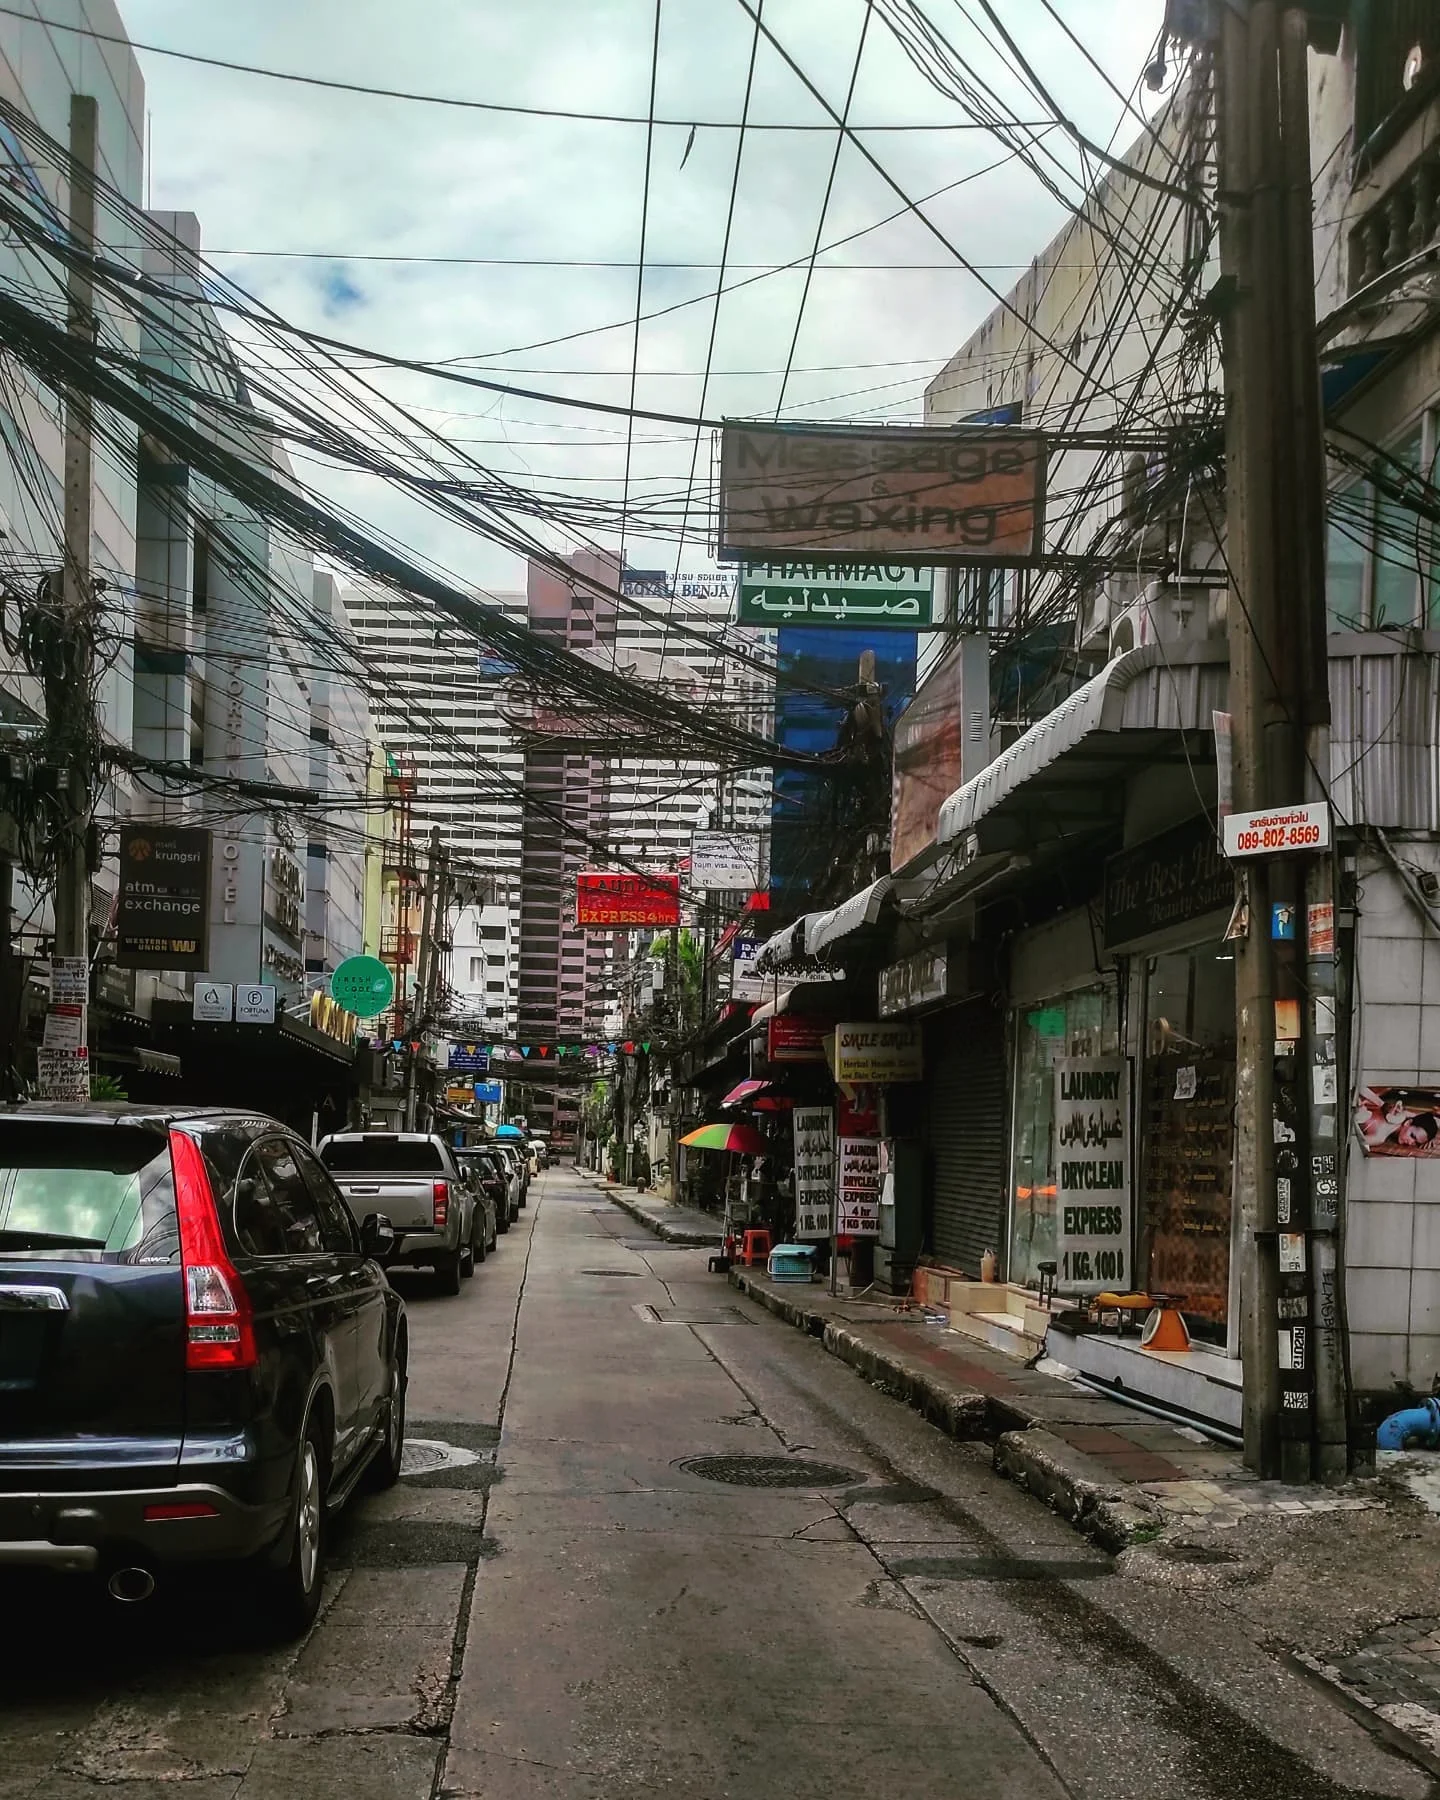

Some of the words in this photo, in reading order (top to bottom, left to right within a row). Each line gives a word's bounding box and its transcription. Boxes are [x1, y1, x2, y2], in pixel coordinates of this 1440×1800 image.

[738, 434, 1026, 484] Massage
[870, 480, 889, 495] &
[760, 494, 999, 546] Waxing
[745, 559, 923, 583] PHARMACY
[682, 584, 729, 598] BENJA
[224, 656, 244, 798] FORTUN
[1237, 825, 1320, 850] 089-802-8569
[155, 848, 200, 864] krungsri
[221, 823, 241, 924] HOTEL
[125, 880, 155, 894] atm
[125, 898, 201, 915] exchange
[581, 909, 647, 923] EXPRESS
[125, 937, 168, 945] WESTERN
[138, 944, 168, 952] UNION
[240, 1006, 270, 1015] FORTUNA
[841, 1032, 877, 1051] SMILE
[1061, 1071, 1121, 1100] LAUNDRY
[844, 1144, 879, 1157] LAUNDR
[1061, 1161, 1124, 1190] DRYCLEAN
[799, 1189, 831, 1206] EXPRESS
[852, 1206, 859, 1216] 4
[860, 1206, 872, 1217] hr
[846, 1219, 860, 1230] KG
[1063, 1206, 1122, 1235] EXPRESS
[1072, 1251, 1094, 1281] KG.
